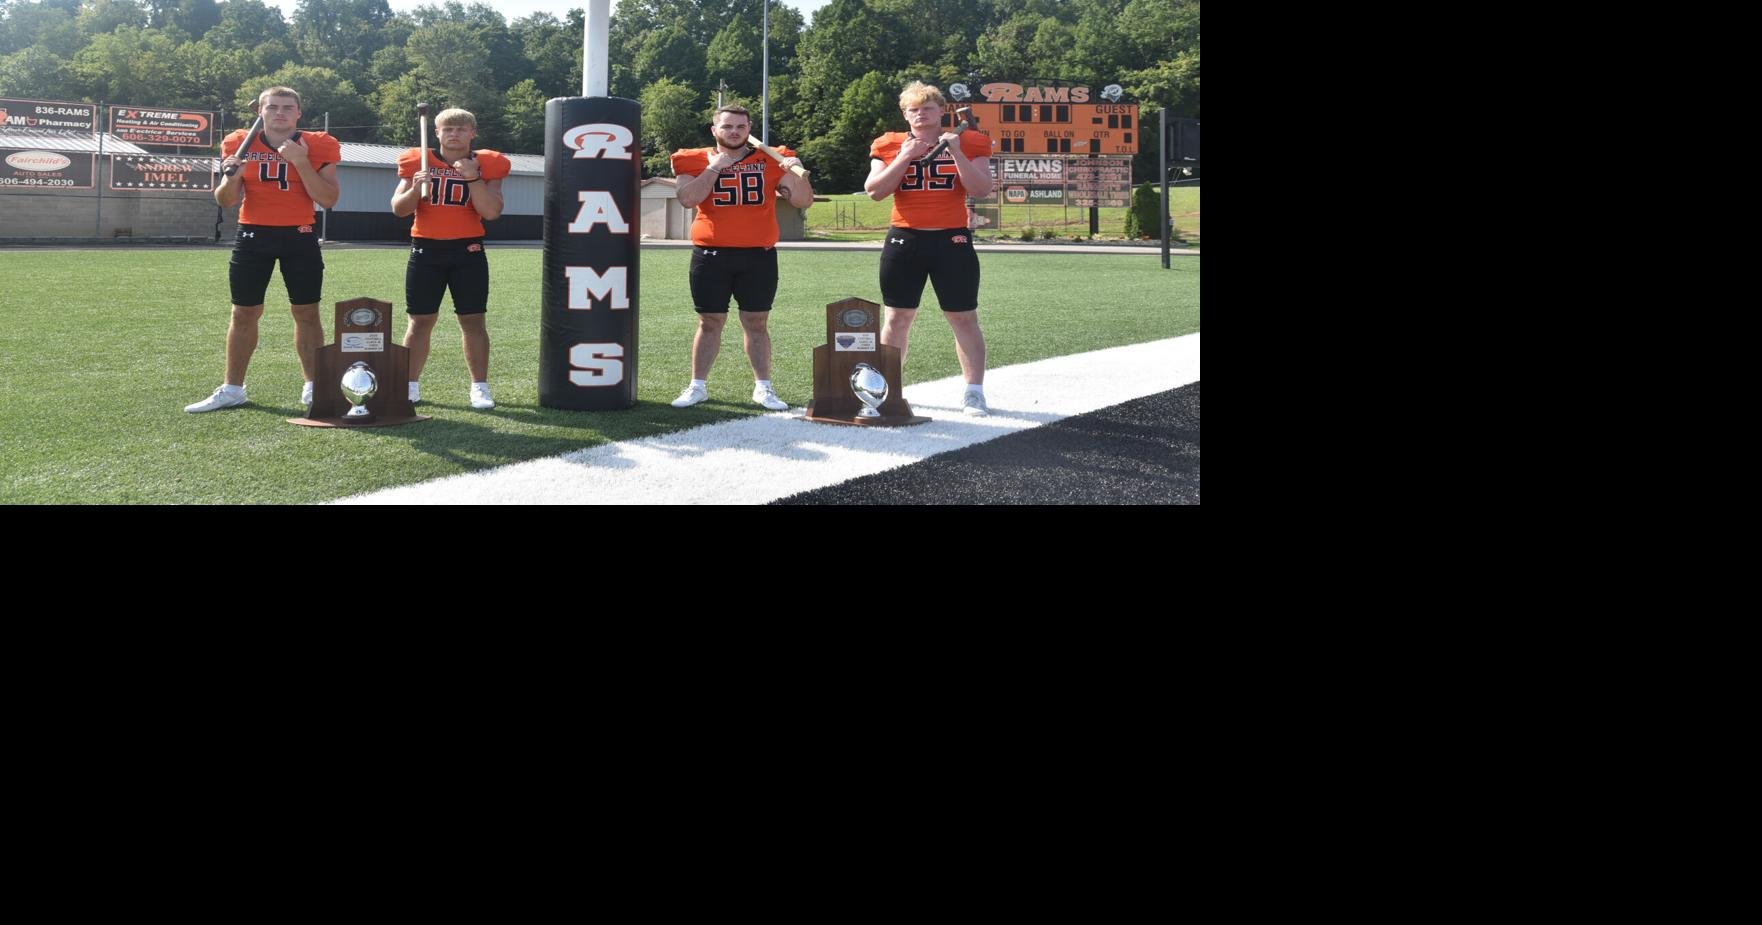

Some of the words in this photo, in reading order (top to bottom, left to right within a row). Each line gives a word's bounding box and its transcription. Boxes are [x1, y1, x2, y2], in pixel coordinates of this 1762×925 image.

[980, 83, 1089, 103] RAMS
[35, 106, 90, 116] 836-RAMS
[118, 109, 178, 119] EXTREME
[1095, 105, 1132, 114] GUEST
[39, 118, 91, 129] Pharmacy
[10, 156, 67, 165] Fairchild's
[1004, 159, 1062, 172] EVANS
[143, 173, 188, 183] IMEL
[259, 161, 289, 191] 4
[900, 159, 958, 191] 35
[429, 176, 471, 207] 10
[712, 171, 765, 206] 58
[1008, 190, 1025, 198] NAPA
[1030, 190, 1062, 198] ASHLAND
